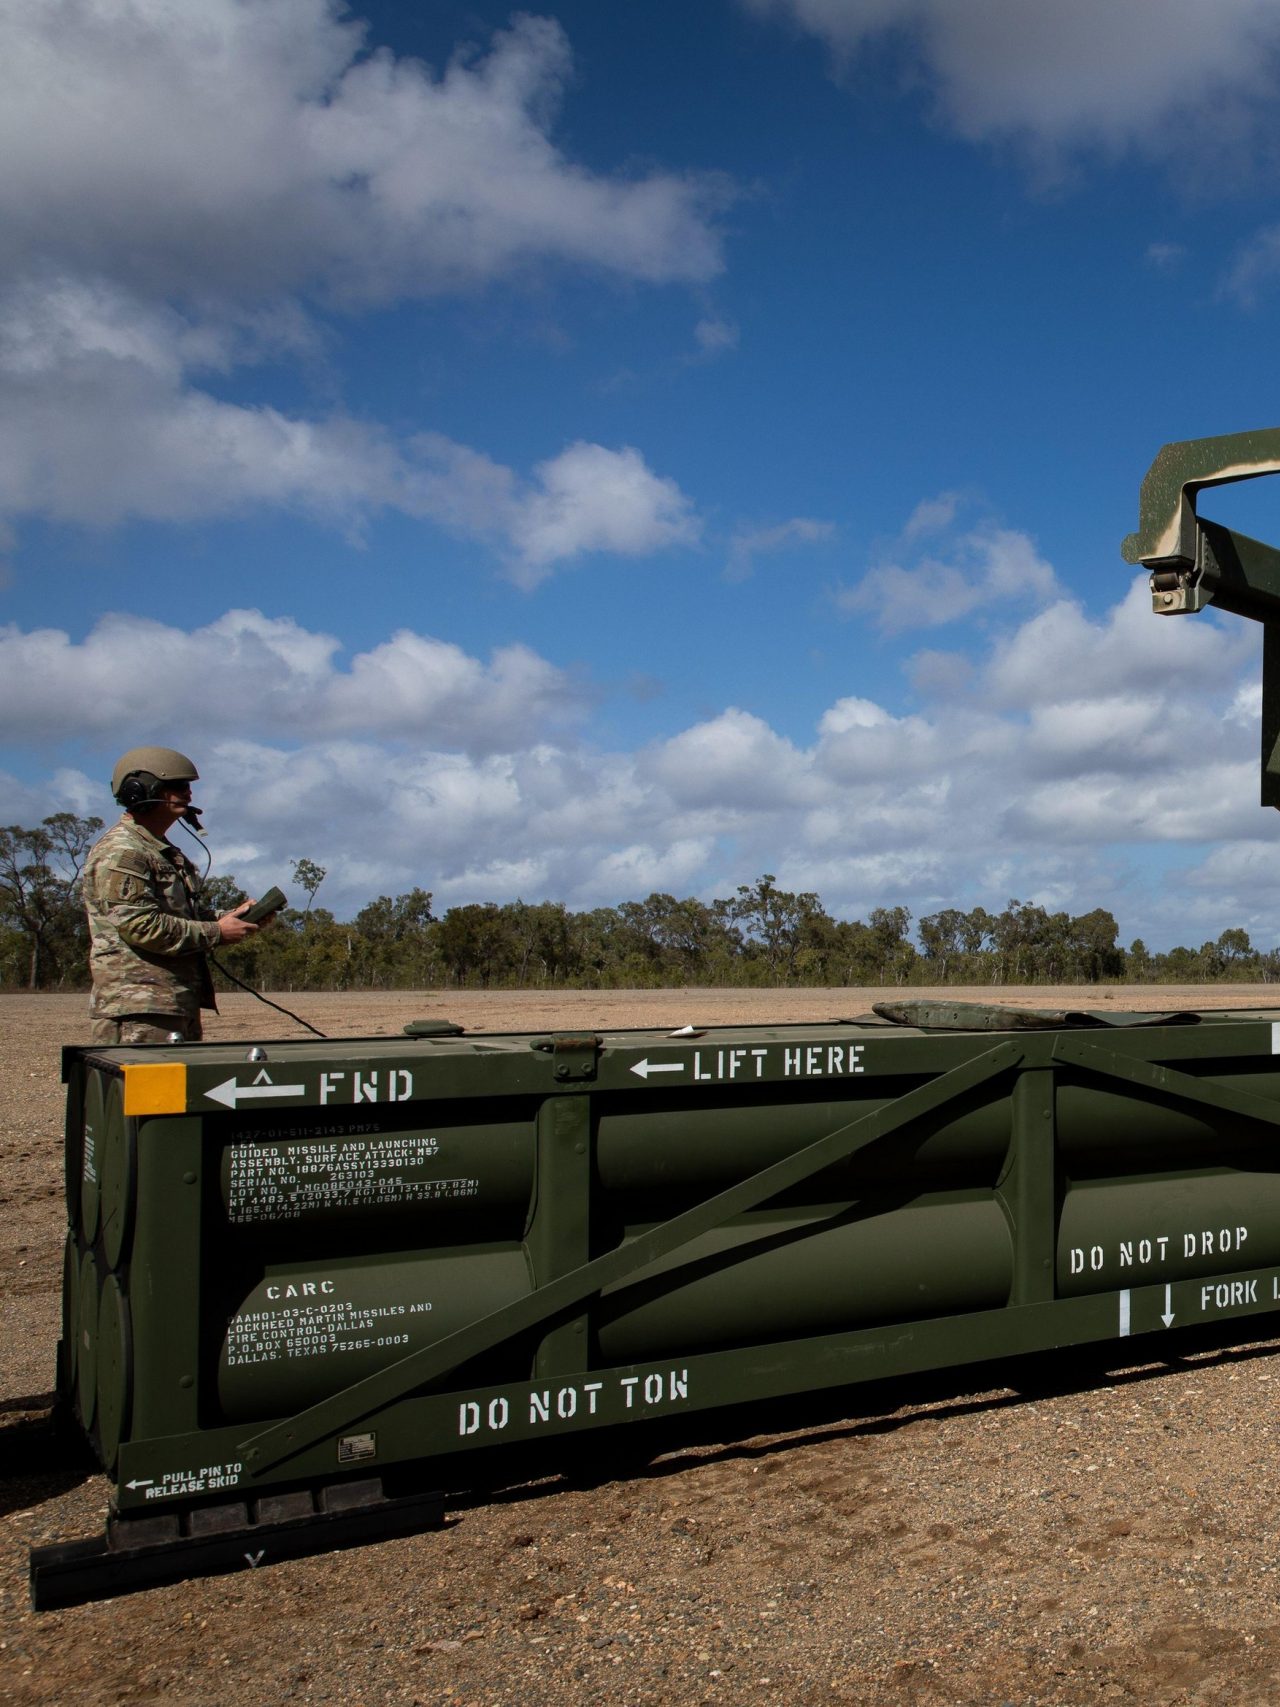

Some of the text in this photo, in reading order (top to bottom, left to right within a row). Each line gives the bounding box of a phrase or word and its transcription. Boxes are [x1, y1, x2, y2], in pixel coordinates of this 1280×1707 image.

[694, 1045, 865, 1080] LIFT HERE
[320, 1070, 413, 1105] FWD
[231, 1138, 437, 1159] GUIDED MISSILE AND LAUNCHING
[306, 1152, 360, 1164] SURFACE
[417, 1147, 440, 1157] M57
[230, 1168, 263, 1179] PART
[269, 1167, 291, 1176] NO.
[230, 1170, 375, 1188] SERIAL NO. 263103
[229, 1198, 245, 1207] WT
[230, 1188, 255, 1198] LOT
[261, 1186, 283, 1195] NO.
[1071, 1226, 1248, 1274] DO NOT DROP
[266, 1280, 335, 1300] CARC
[1201, 1279, 1258, 1311] FORK
[227, 1302, 432, 1335] LOCKHEED MARTIN MISSILES AND
[227, 1319, 374, 1345] FIRE CONTROL-DALLAS
[286, 1333, 336, 1348] 650003
[287, 1344, 327, 1357] TEXAS
[332, 1334, 409, 1352] 75265-0003
[459, 1369, 688, 1436] DO NOT TOW
[162, 1463, 242, 1485] PULL PIN TO
[145, 1474, 239, 1499] RELEASE SKID
